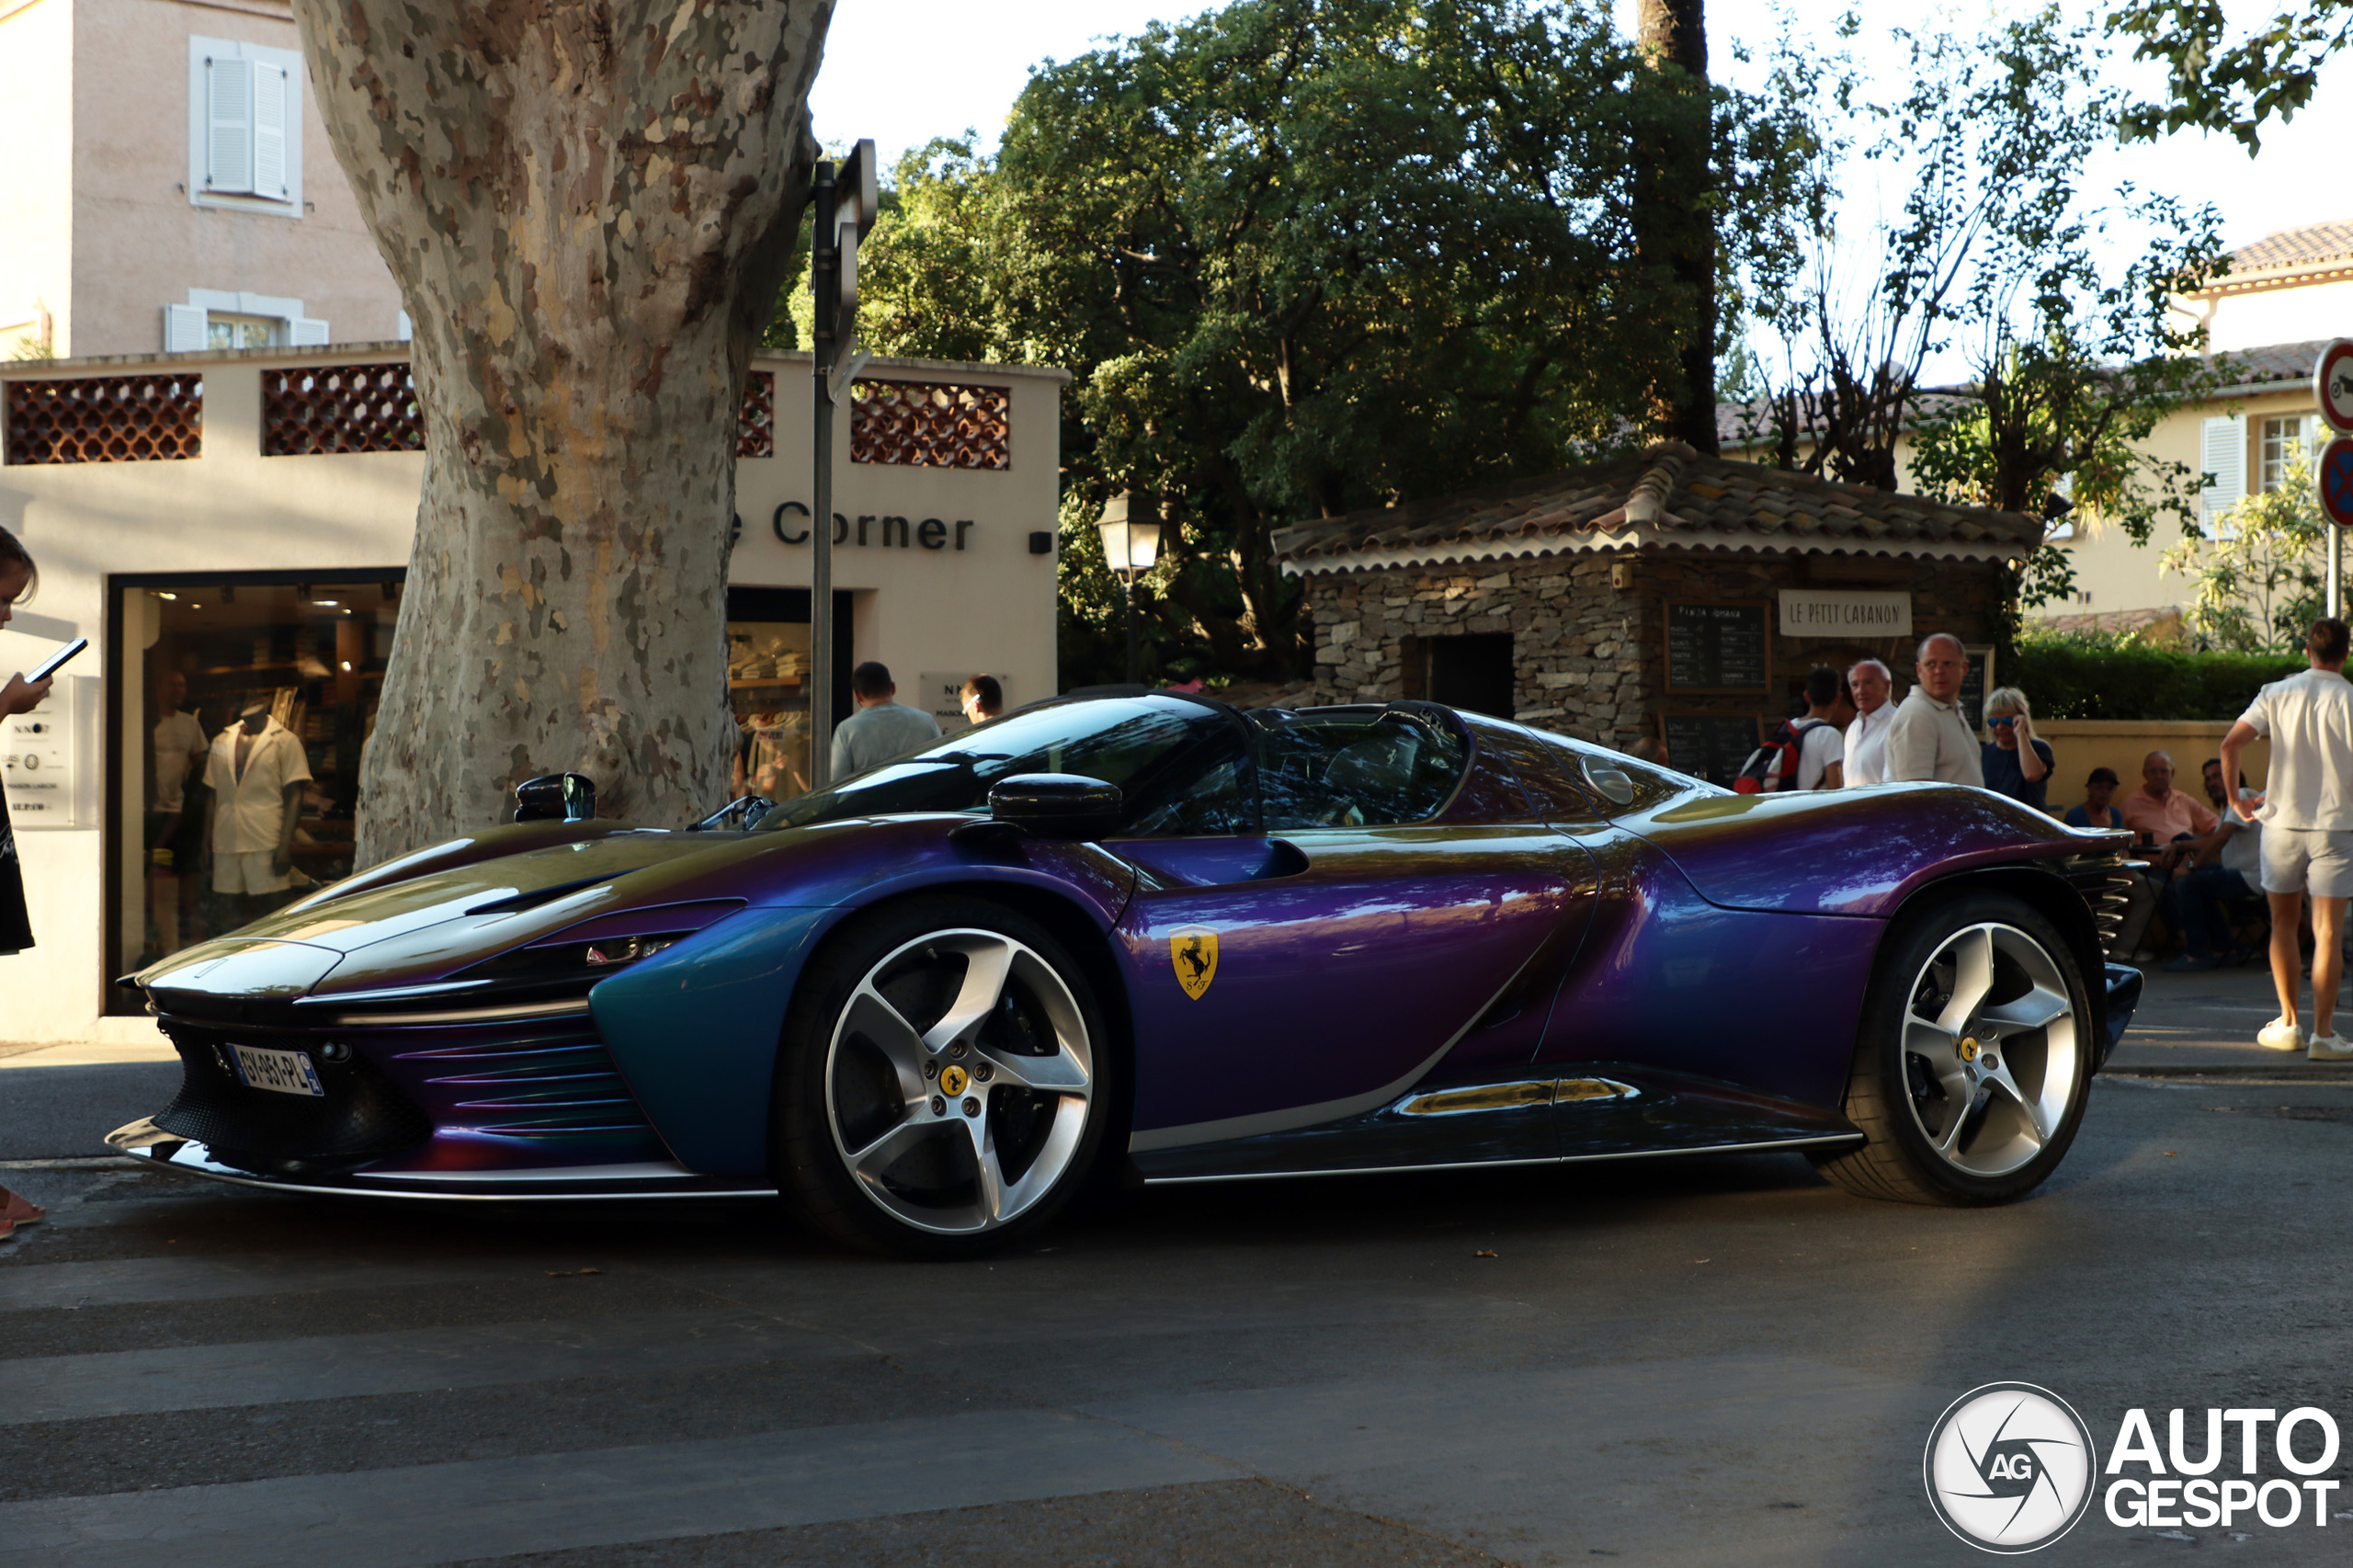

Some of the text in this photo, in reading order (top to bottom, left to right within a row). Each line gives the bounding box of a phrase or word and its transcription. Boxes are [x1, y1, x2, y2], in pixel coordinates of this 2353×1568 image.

[772, 501, 974, 551] Corner
[1790, 603, 1900, 624] LE PETIT CABANON
